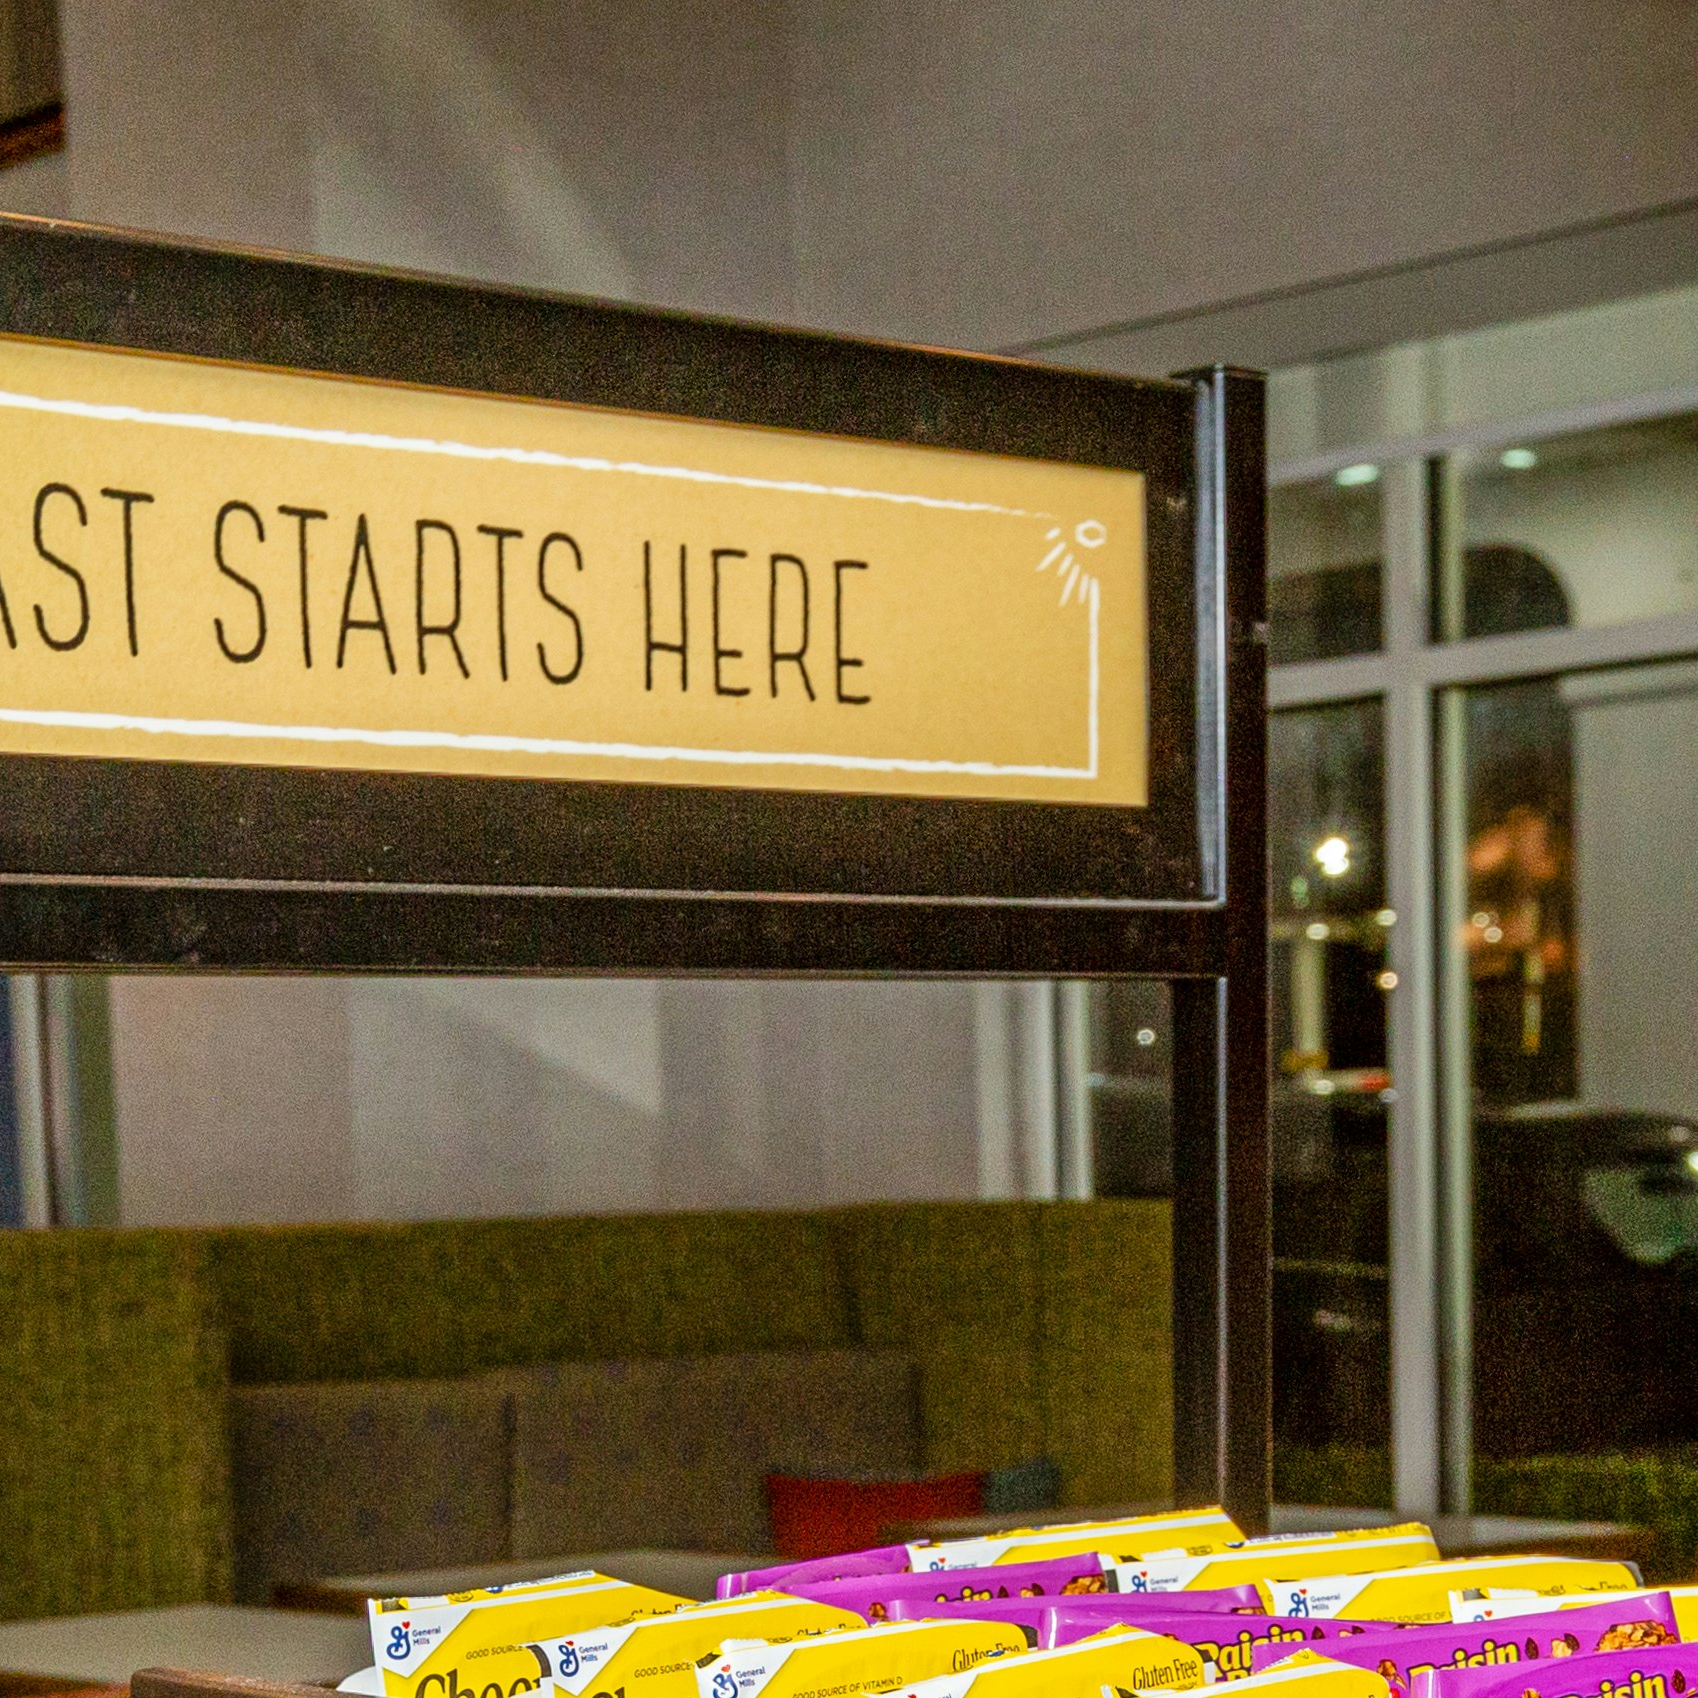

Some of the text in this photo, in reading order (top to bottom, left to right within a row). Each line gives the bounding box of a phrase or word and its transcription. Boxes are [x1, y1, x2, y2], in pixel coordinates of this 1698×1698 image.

[213, 498, 585, 686] STARTS
[643, 538, 873, 705] HERE
[1310, 1593, 1341, 1603] General
[412, 1625, 442, 1638] General
[412, 1637, 431, 1647] Mills
[578, 1642, 609, 1654] General
[465, 1650, 489, 1661] GOOD
[581, 1653, 599, 1662] Mills
[634, 1662, 692, 1679] GOOD SOURCE
[735, 1666, 766, 1679] General
[1133, 1657, 1198, 1691] Gluten Free
[738, 1679, 756, 1689] Mills
[849, 1683, 862, 1694] OF
[863, 1678, 895, 1692] VITAMIN
[896, 1676, 903, 1685] D
